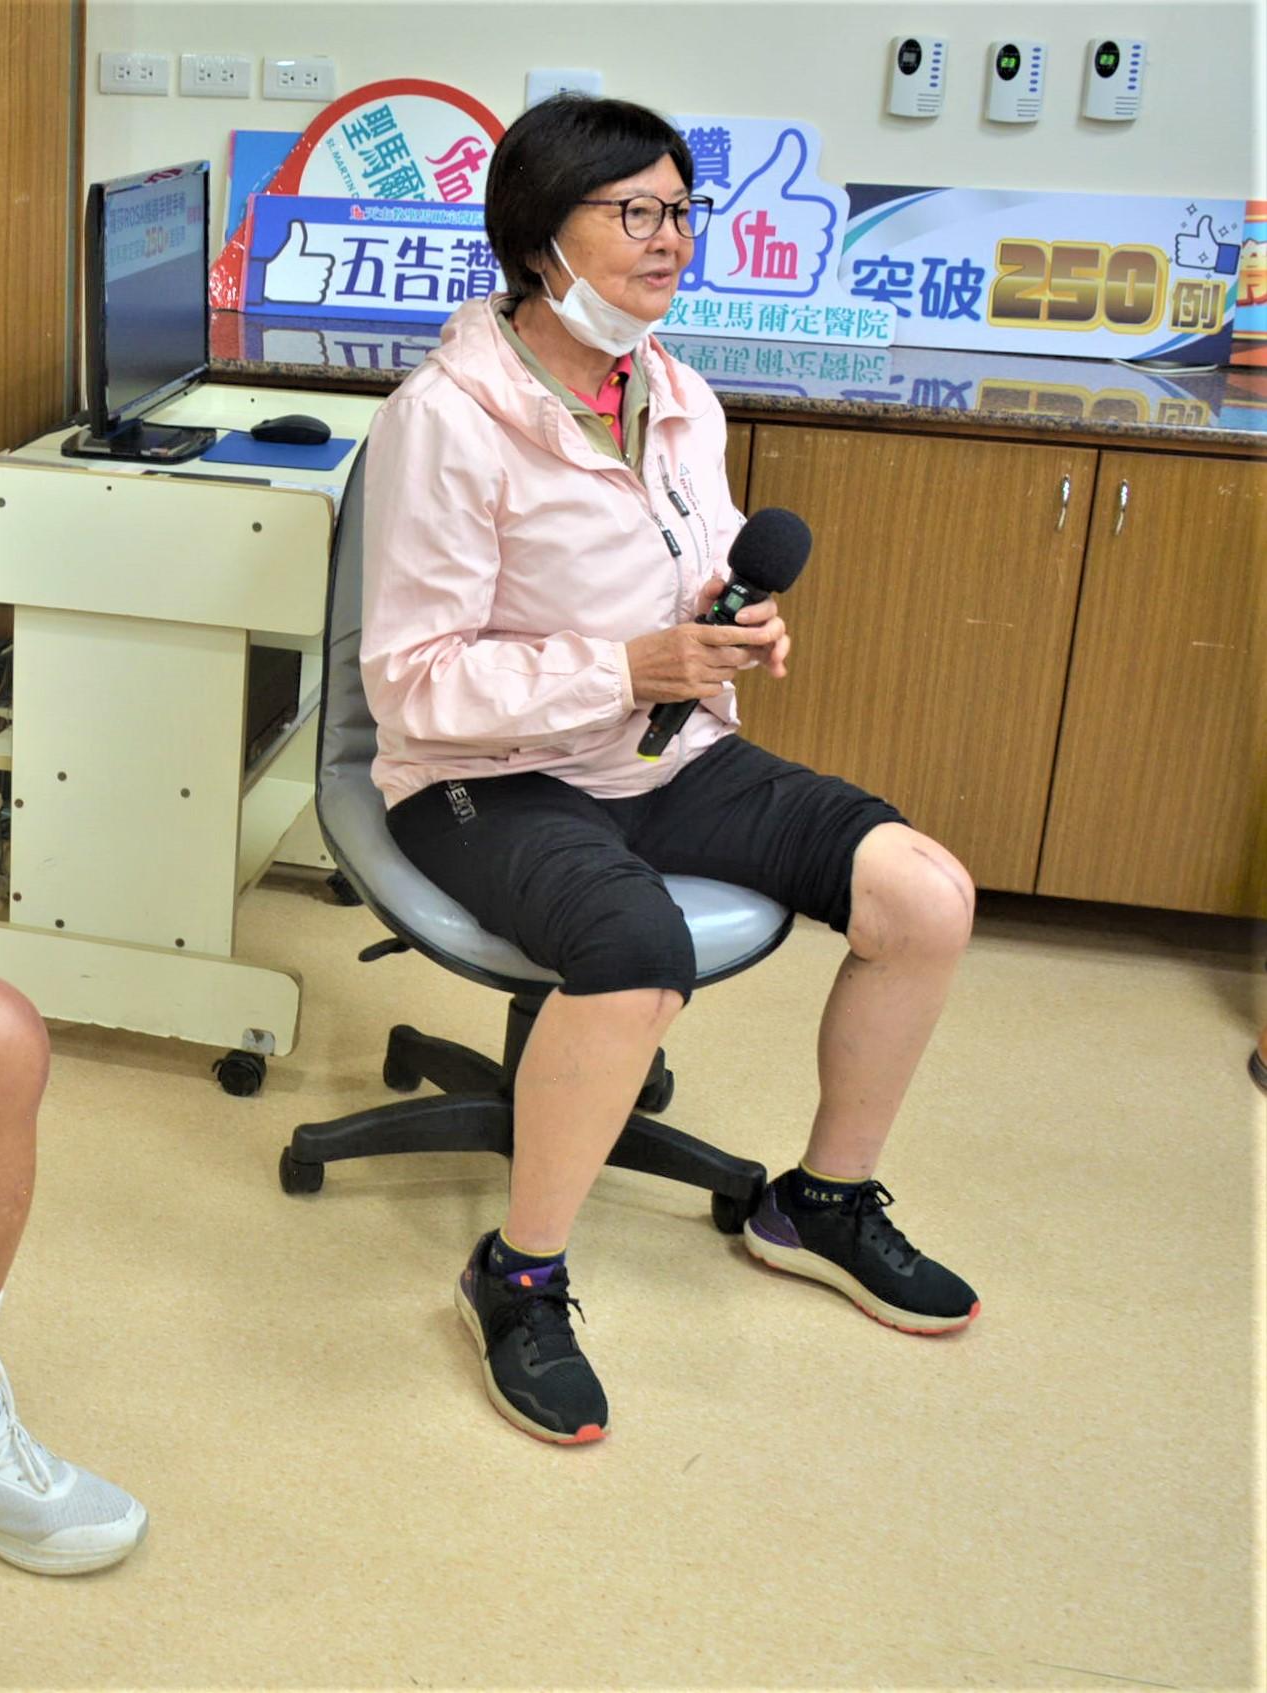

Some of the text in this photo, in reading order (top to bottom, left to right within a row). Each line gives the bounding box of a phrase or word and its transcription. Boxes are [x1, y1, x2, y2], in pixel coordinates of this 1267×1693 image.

[331, 151, 356, 192] MARTIN
[341, 104, 432, 201] 聖馬爾
[336, 235, 500, 303] 五告讚
